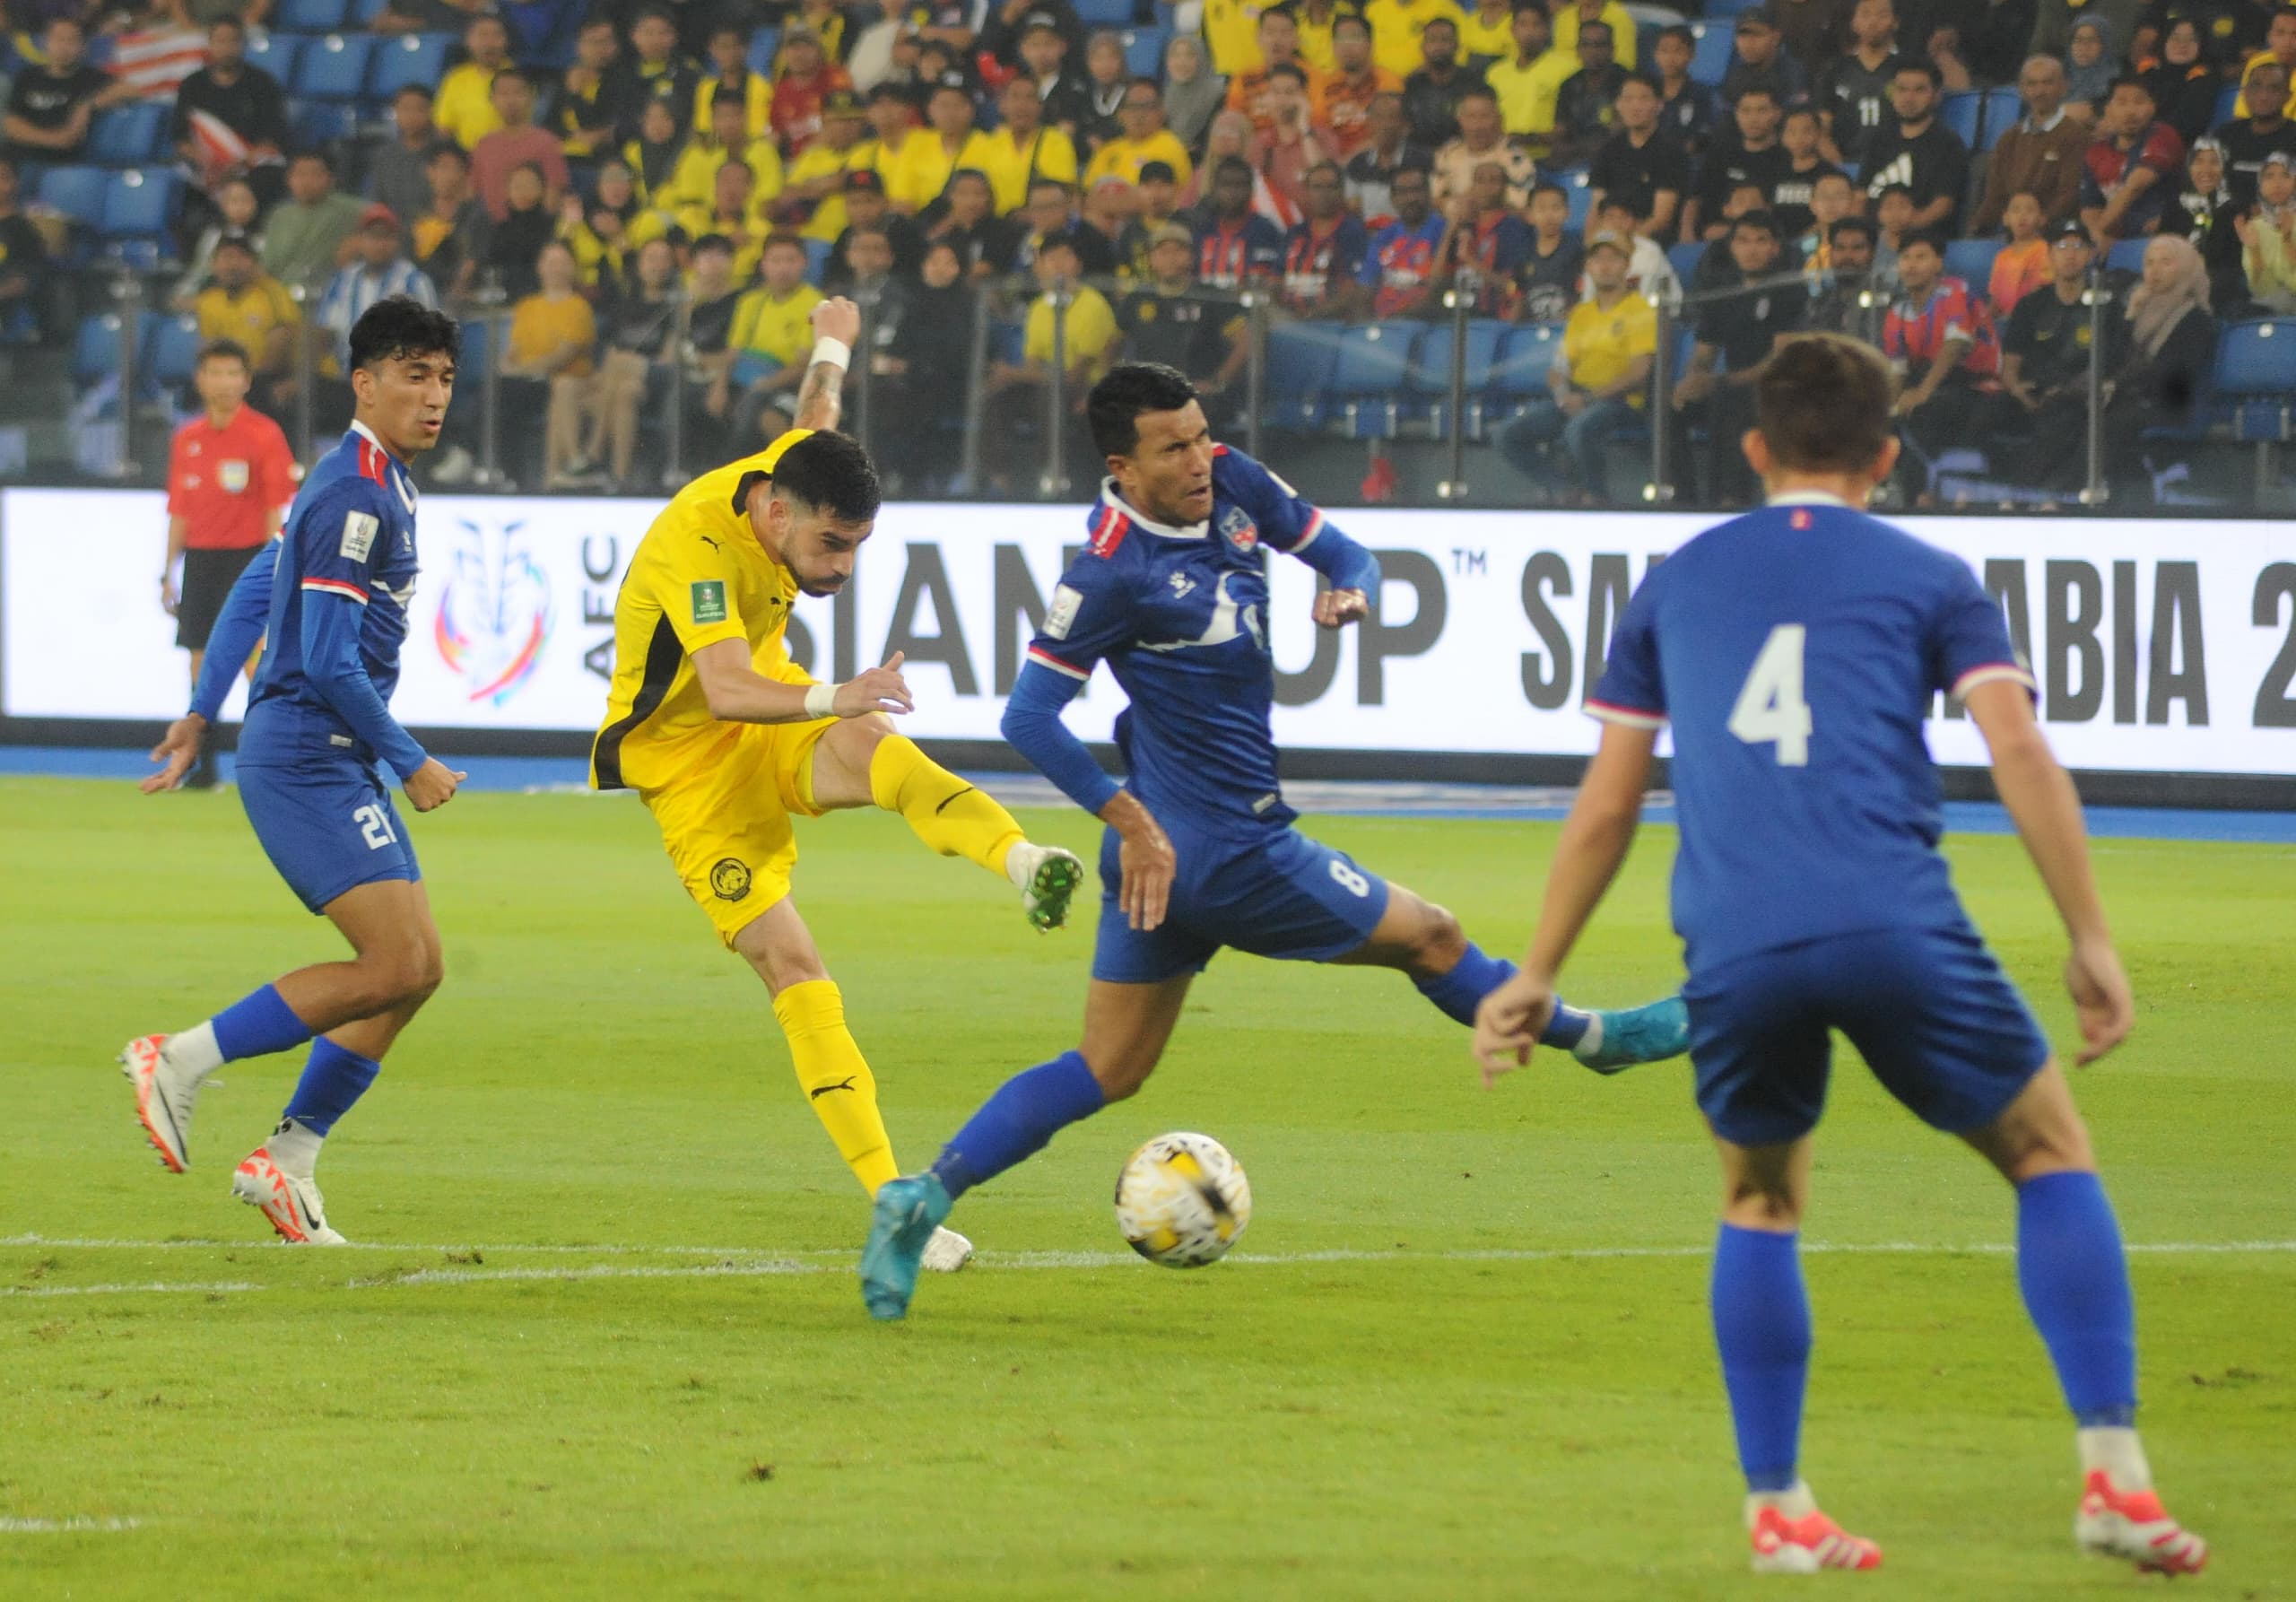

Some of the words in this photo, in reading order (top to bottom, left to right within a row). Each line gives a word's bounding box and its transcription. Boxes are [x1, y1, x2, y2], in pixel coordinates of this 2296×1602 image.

[583, 536, 616, 683] AFC
[1727, 624, 1813, 767] 4
[353, 804, 397, 850] 21
[1329, 859, 1370, 897] 8
